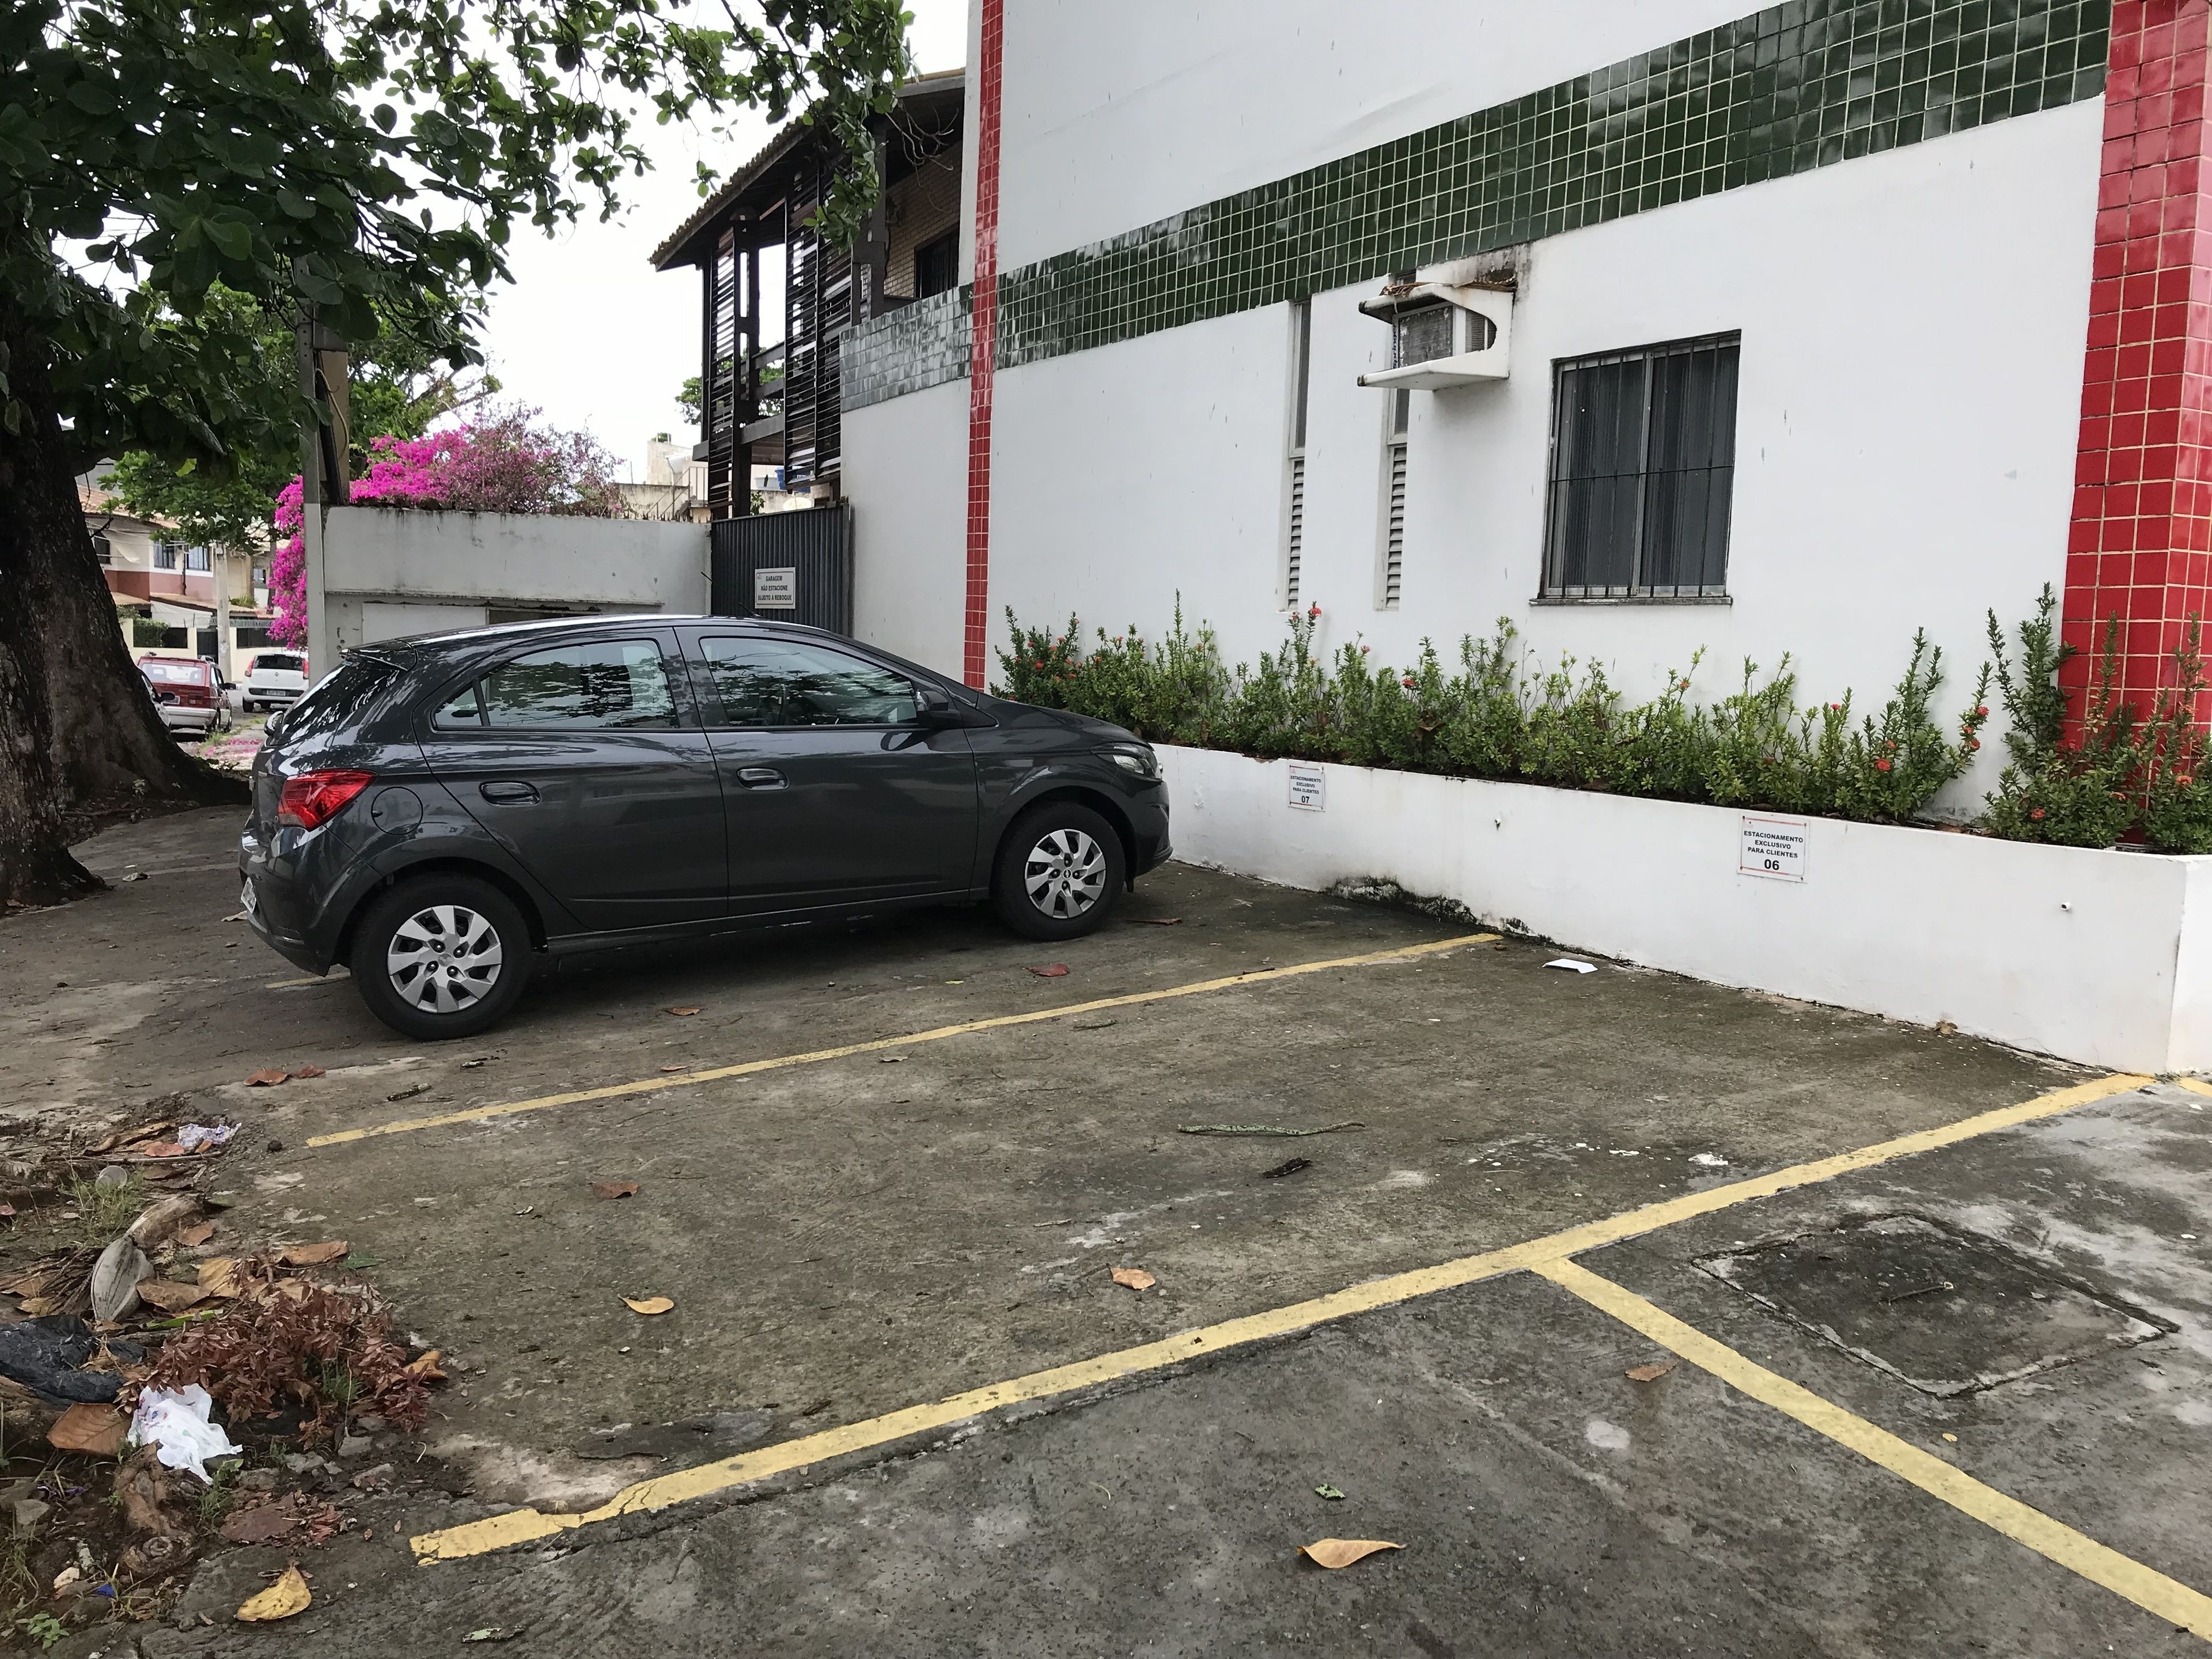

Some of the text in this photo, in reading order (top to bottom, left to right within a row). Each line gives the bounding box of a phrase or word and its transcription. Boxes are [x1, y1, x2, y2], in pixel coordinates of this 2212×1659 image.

[1301, 796, 1310, 804] 07
[1744, 831, 1804, 843] ESTACIONAMENTO
[1755, 839, 1791, 849] EXCLUSIVO
[1766, 849, 1798, 858] CLIENTES
[1764, 858, 1780, 871] 06
